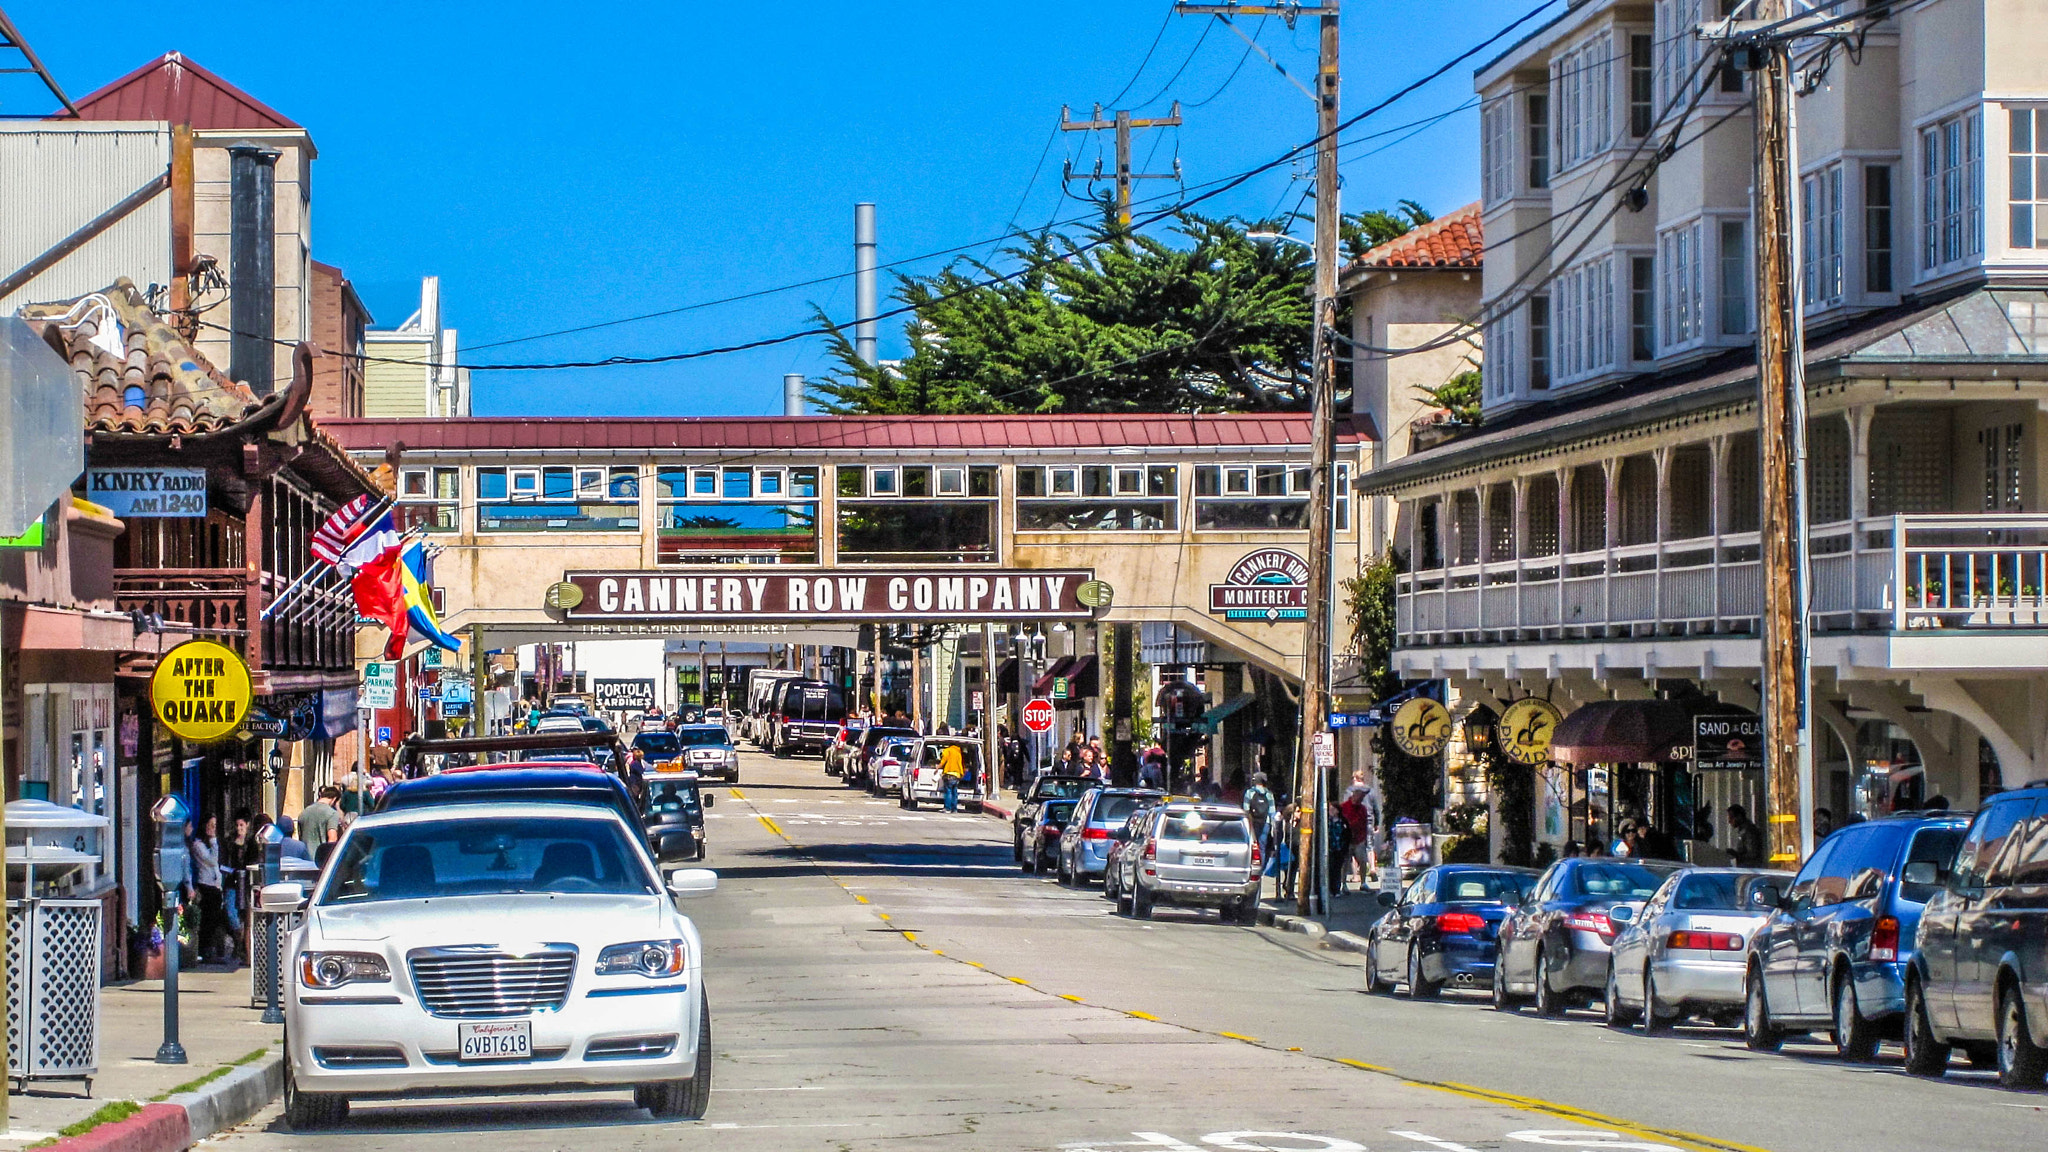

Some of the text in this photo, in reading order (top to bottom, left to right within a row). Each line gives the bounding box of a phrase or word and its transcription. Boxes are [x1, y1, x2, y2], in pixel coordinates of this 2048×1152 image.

[92, 472, 205, 491] KNRY RADIO
[130, 494, 204, 513] AM 1240
[1234, 554, 1309, 584] CANNERY ROW
[599, 577, 1067, 612] CANNERY ROW COMPANY
[1225, 590, 1308, 606] MONTEREY, C
[582, 624, 789, 635] THE CLEMENT MONTEREY
[172, 658, 225, 676] AFTER
[371, 665, 377, 675] 2
[184, 679, 215, 698] THE
[368, 678, 393, 687] PARKING
[595, 683, 653, 699] PORTOLA
[595, 698, 651, 706] SARDINES
[163, 700, 236, 724] QUAKE
[1025, 709, 1053, 722] STOP
[1358, 717, 1375, 725] SO
[1700, 722, 1730, 735] SAND
[1741, 722, 1764, 735] GLA
[473, 1024, 517, 1035] California
[465, 1035, 527, 1054] 6VBT618
